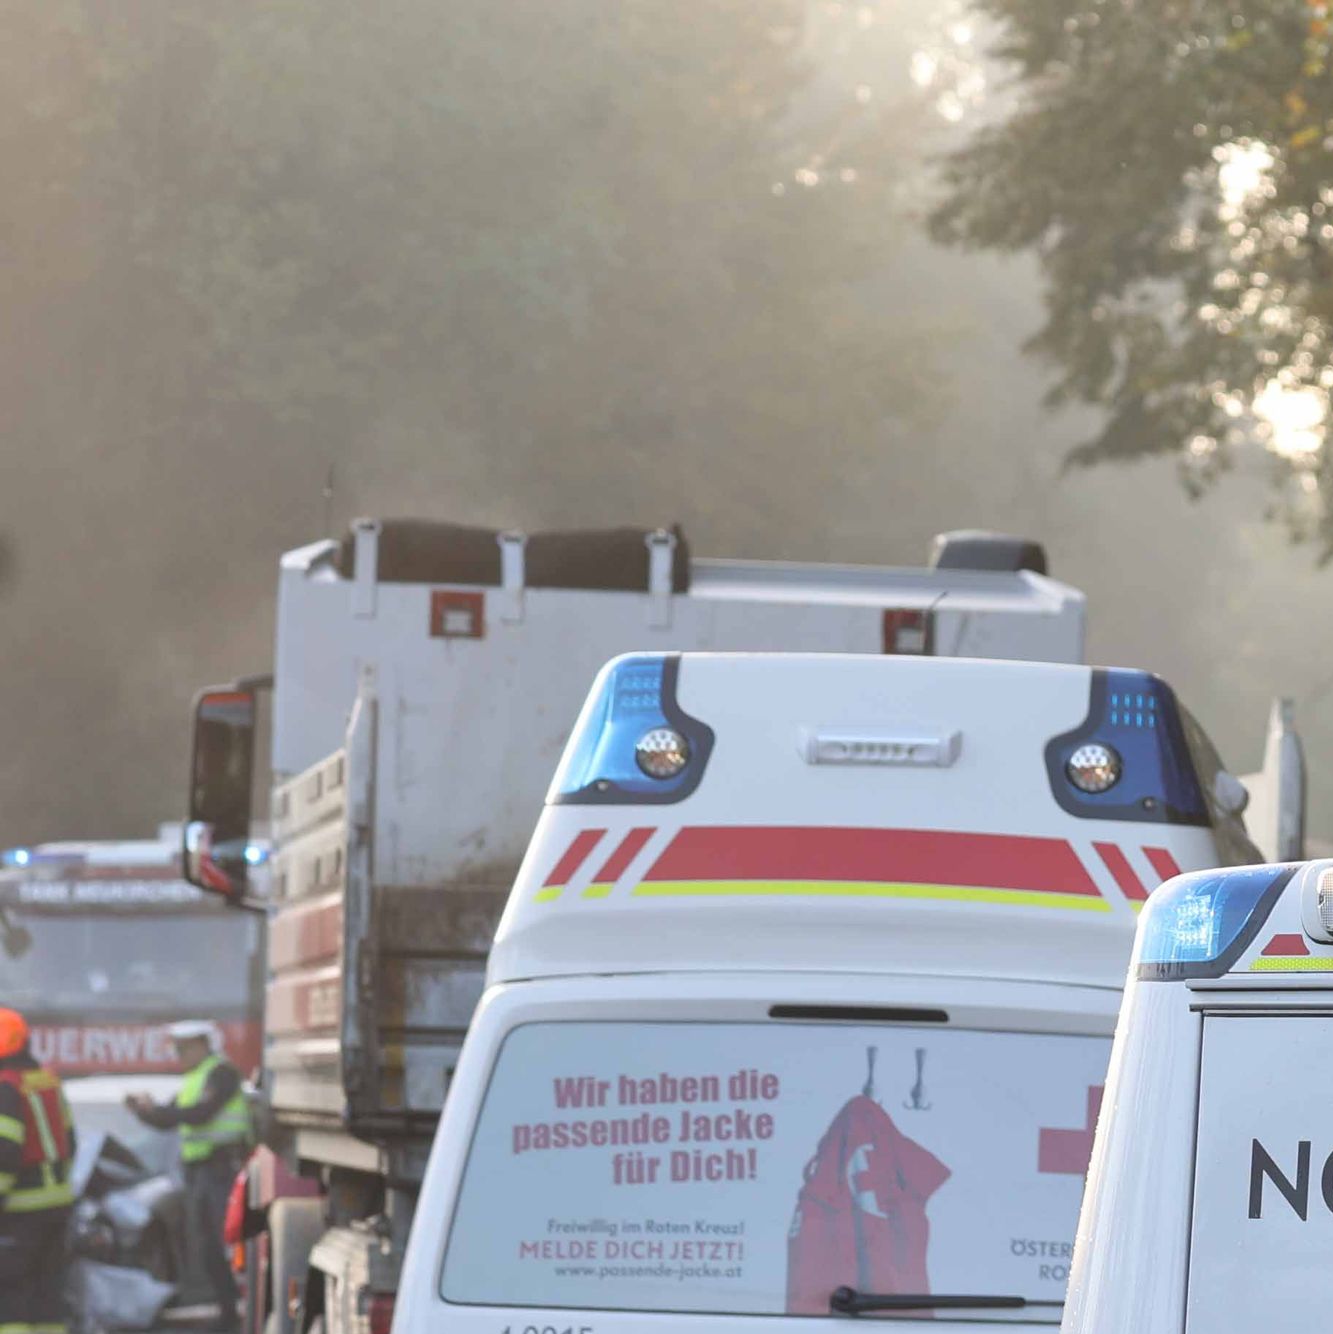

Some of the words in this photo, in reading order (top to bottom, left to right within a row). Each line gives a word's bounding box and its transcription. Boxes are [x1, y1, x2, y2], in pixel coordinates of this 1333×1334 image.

[554, 1076, 610, 1109] Wir
[618, 1072, 720, 1106] haben
[728, 1068, 780, 1101] die
[512, 1112, 671, 1155] passende
[678, 1108, 774, 1143] Jacke
[612, 1151, 661, 1185] für
[669, 1147, 758, 1183] Dich!
[546, 1218, 618, 1237] Freiwillig
[621, 1221, 642, 1235] im
[645, 1219, 691, 1236] Roten
[518, 1239, 598, 1261] MELDE
[604, 1240, 664, 1261] DICH
[668, 1241, 745, 1262] JETZT!
[1009, 1237, 1072, 1258] ÖSTER
[554, 1262, 744, 1282] www.passende-jacke.at
[1038, 1263, 1068, 1282] RO
